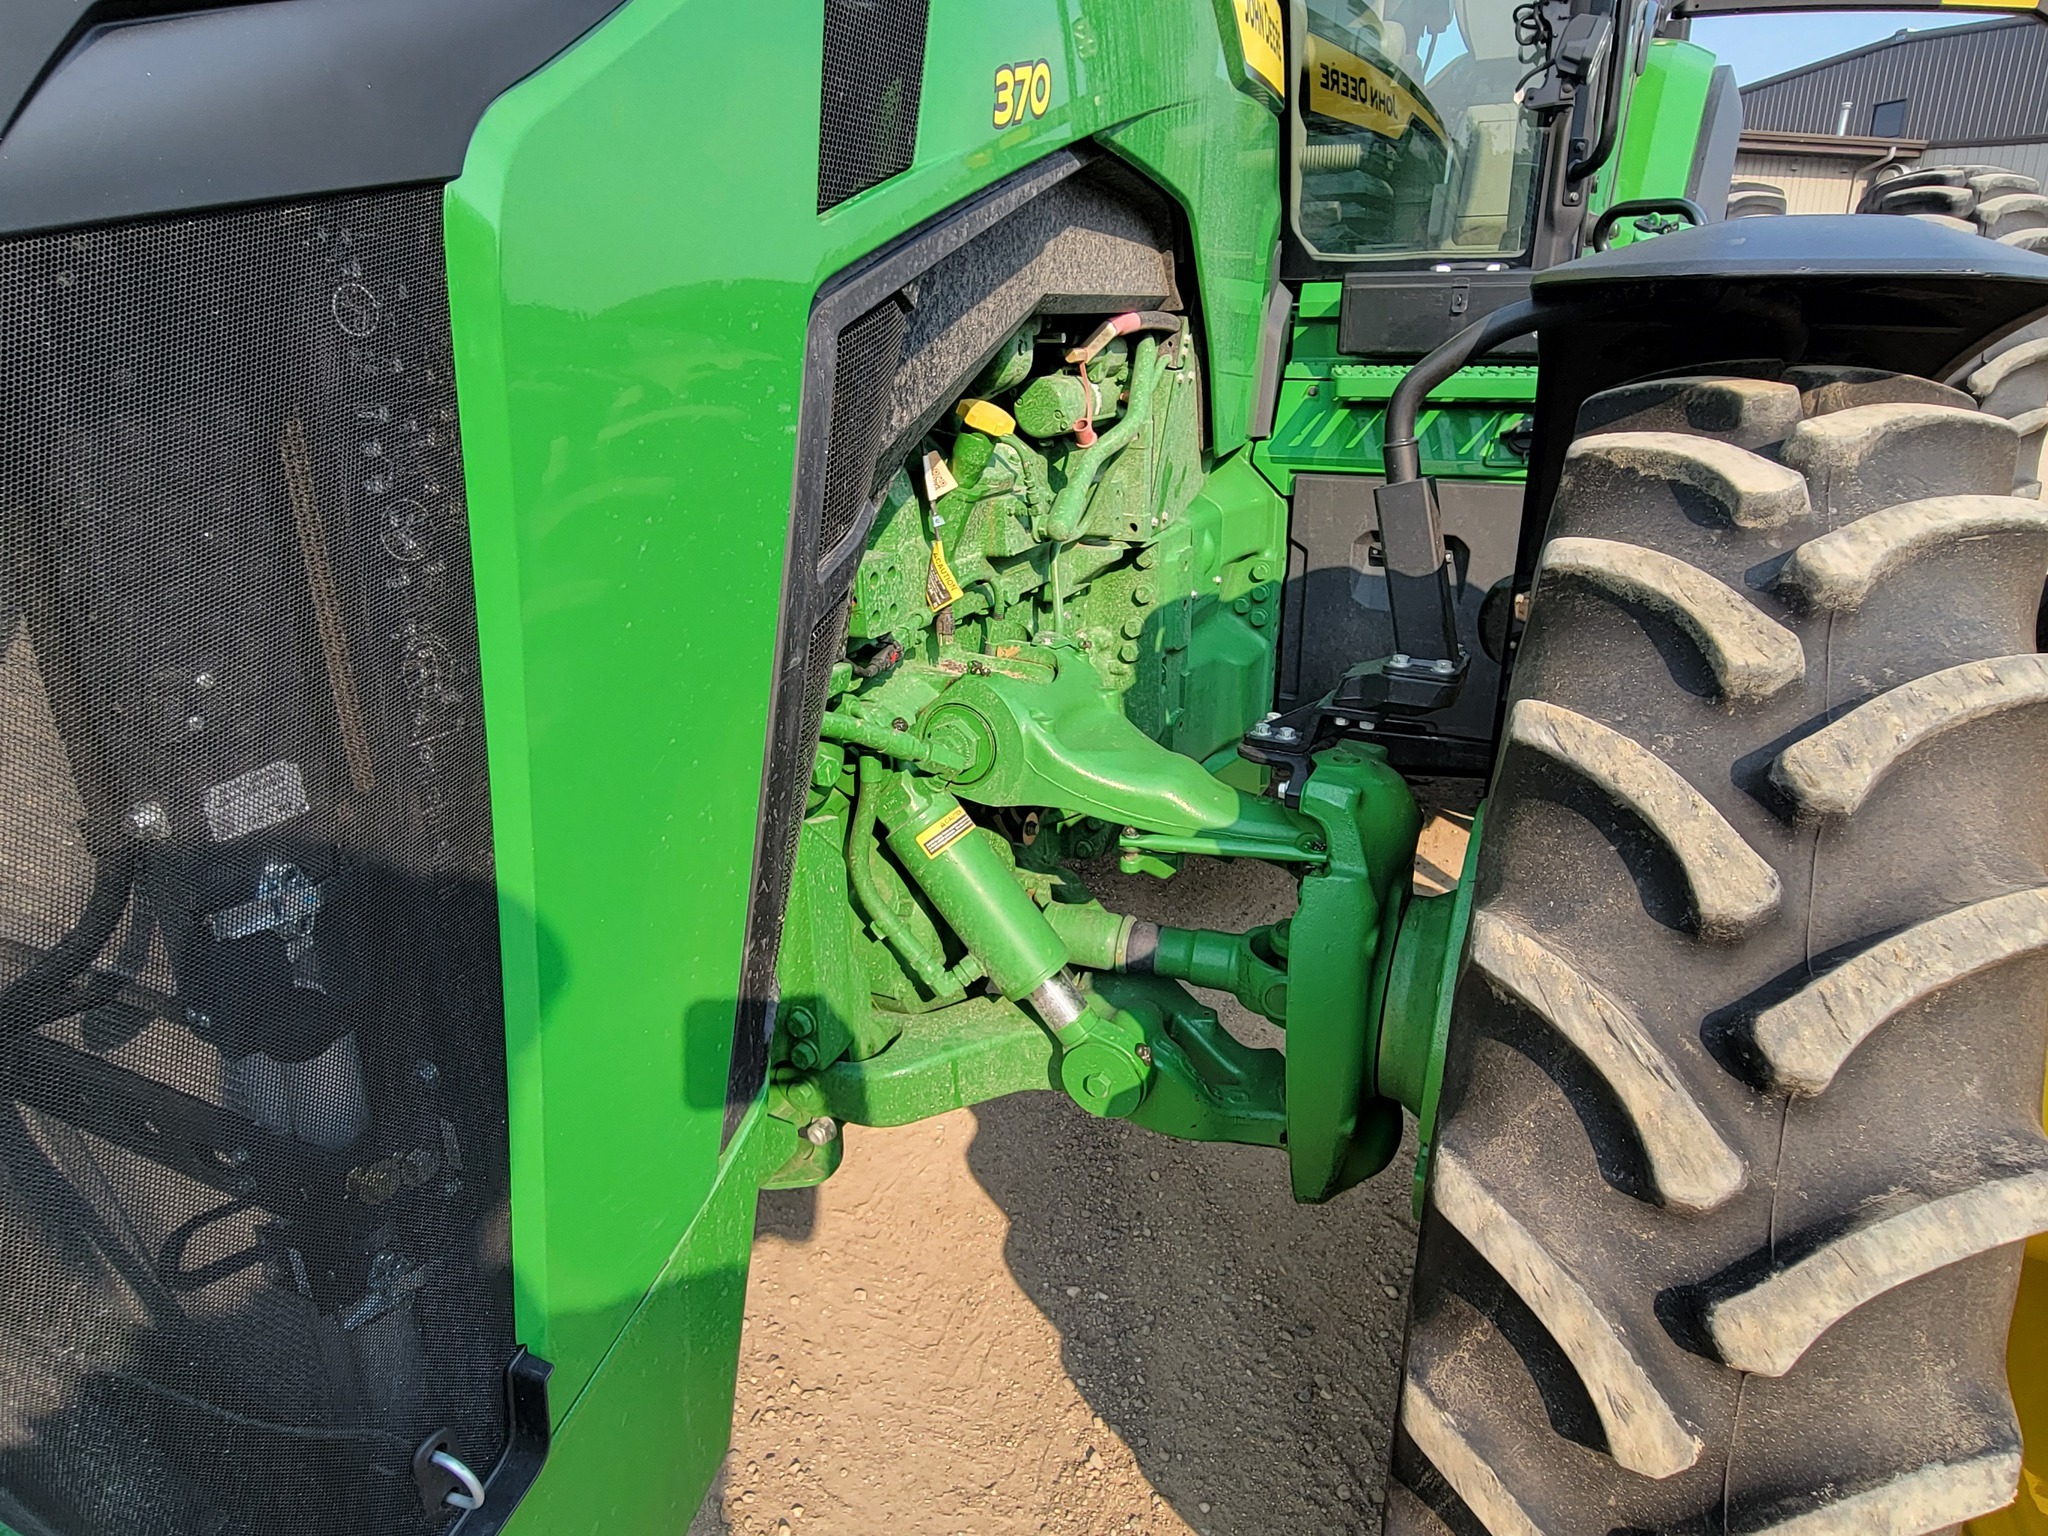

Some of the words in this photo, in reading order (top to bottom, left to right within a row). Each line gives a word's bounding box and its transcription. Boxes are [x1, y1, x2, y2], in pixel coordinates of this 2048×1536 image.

[993, 58, 1051, 130] 370
[934, 557, 958, 591] CAUTION
[944, 809, 962, 825] CAUTIO
